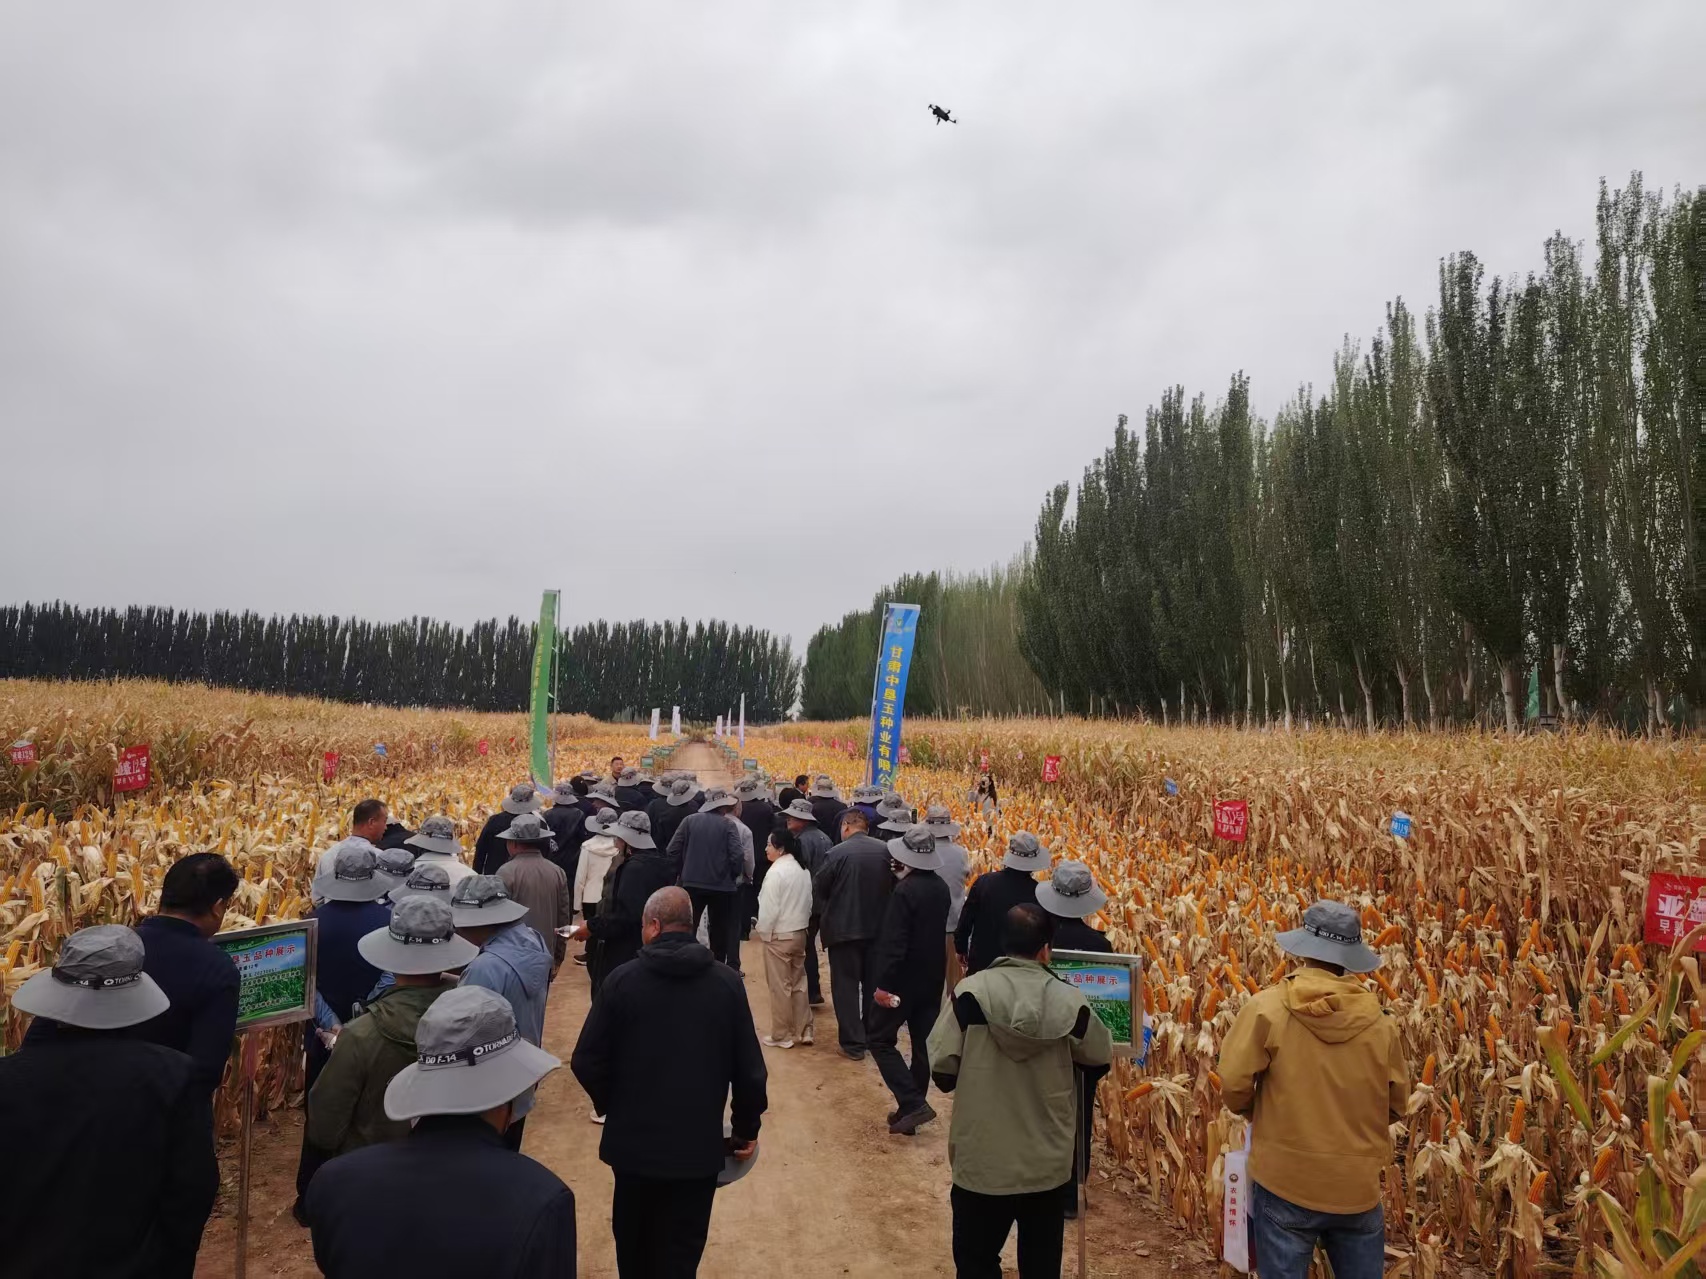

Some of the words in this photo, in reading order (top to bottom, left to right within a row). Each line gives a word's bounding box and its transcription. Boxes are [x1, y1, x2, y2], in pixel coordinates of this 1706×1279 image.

[1056, 972, 1118, 986] 玉品种展示
[437, 1053, 457, 1064] F-14
